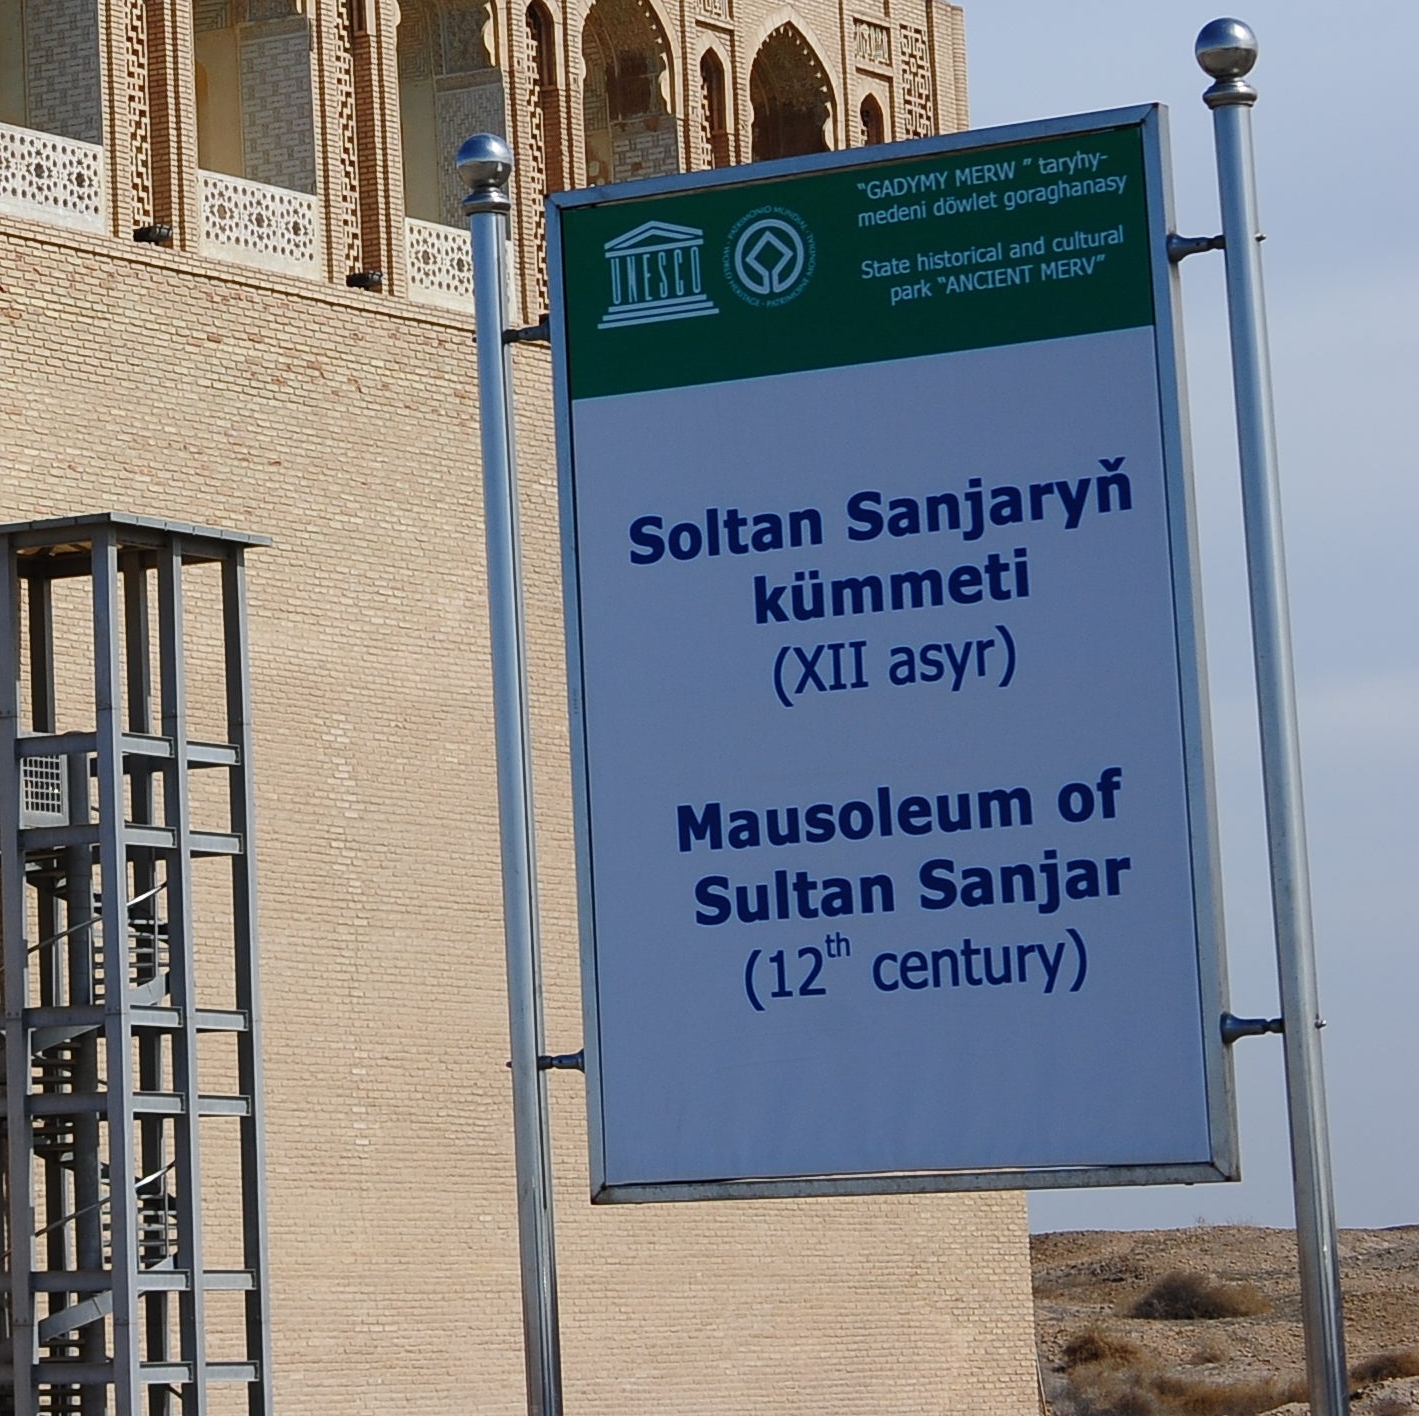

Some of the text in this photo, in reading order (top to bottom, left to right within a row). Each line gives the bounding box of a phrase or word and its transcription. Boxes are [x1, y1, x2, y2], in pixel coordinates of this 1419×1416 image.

[1037, 150, 1108, 175] taryhy-
[857, 175, 1128, 228] medeni döwlet goraghanasy
[610, 246, 701, 304] UNESCO
[861, 224, 1124, 279] State historical and cultural
[890, 254, 1106, 306] park “ANCIENT MERV”
[628, 456, 1133, 565] Soltan Sanjaryň
[753, 547, 1030, 624] kümmeti
[772, 625, 1016, 708] (XII asyr)
[676, 766, 1123, 853] Mausoleum of
[694, 849, 1131, 926] Sultan Sanjar
[871, 928, 1088, 994] century)
